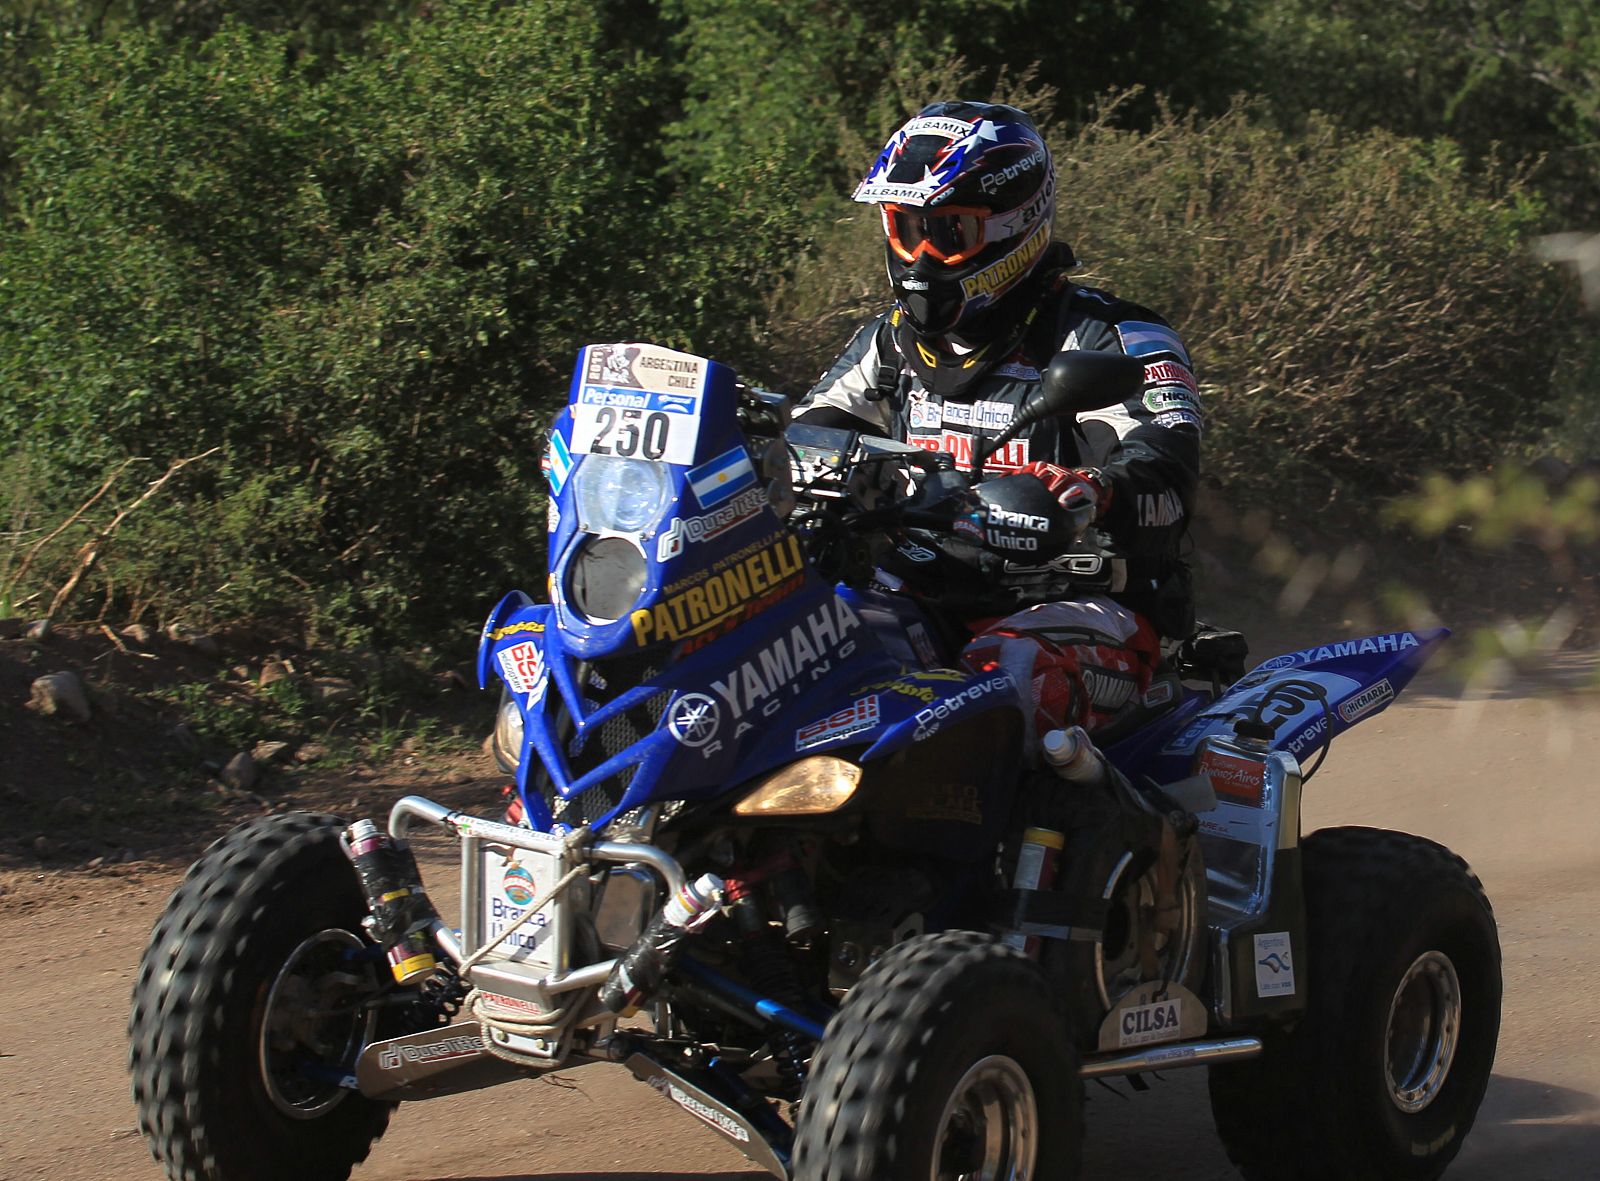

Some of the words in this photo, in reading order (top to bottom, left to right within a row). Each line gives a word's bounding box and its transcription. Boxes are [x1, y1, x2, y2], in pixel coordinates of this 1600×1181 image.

[908, 121, 971, 139] ALBAMIX
[862, 187, 929, 201] ALBAMIX
[640, 356, 699, 374] ARGENTINA
[668, 374, 697, 389] CHILE
[584, 388, 651, 410] Personal
[590, 406, 670, 460] 250
[988, 504, 1050, 533] Branca
[986, 528, 1038, 551] Unico
[629, 534, 804, 648] PATRONELLI
[709, 593, 861, 720] YAMAHA
[1294, 631, 1420, 664] YAMAHA
[701, 639, 858, 760] RACING
[1122, 1005, 1179, 1035] CILSA
